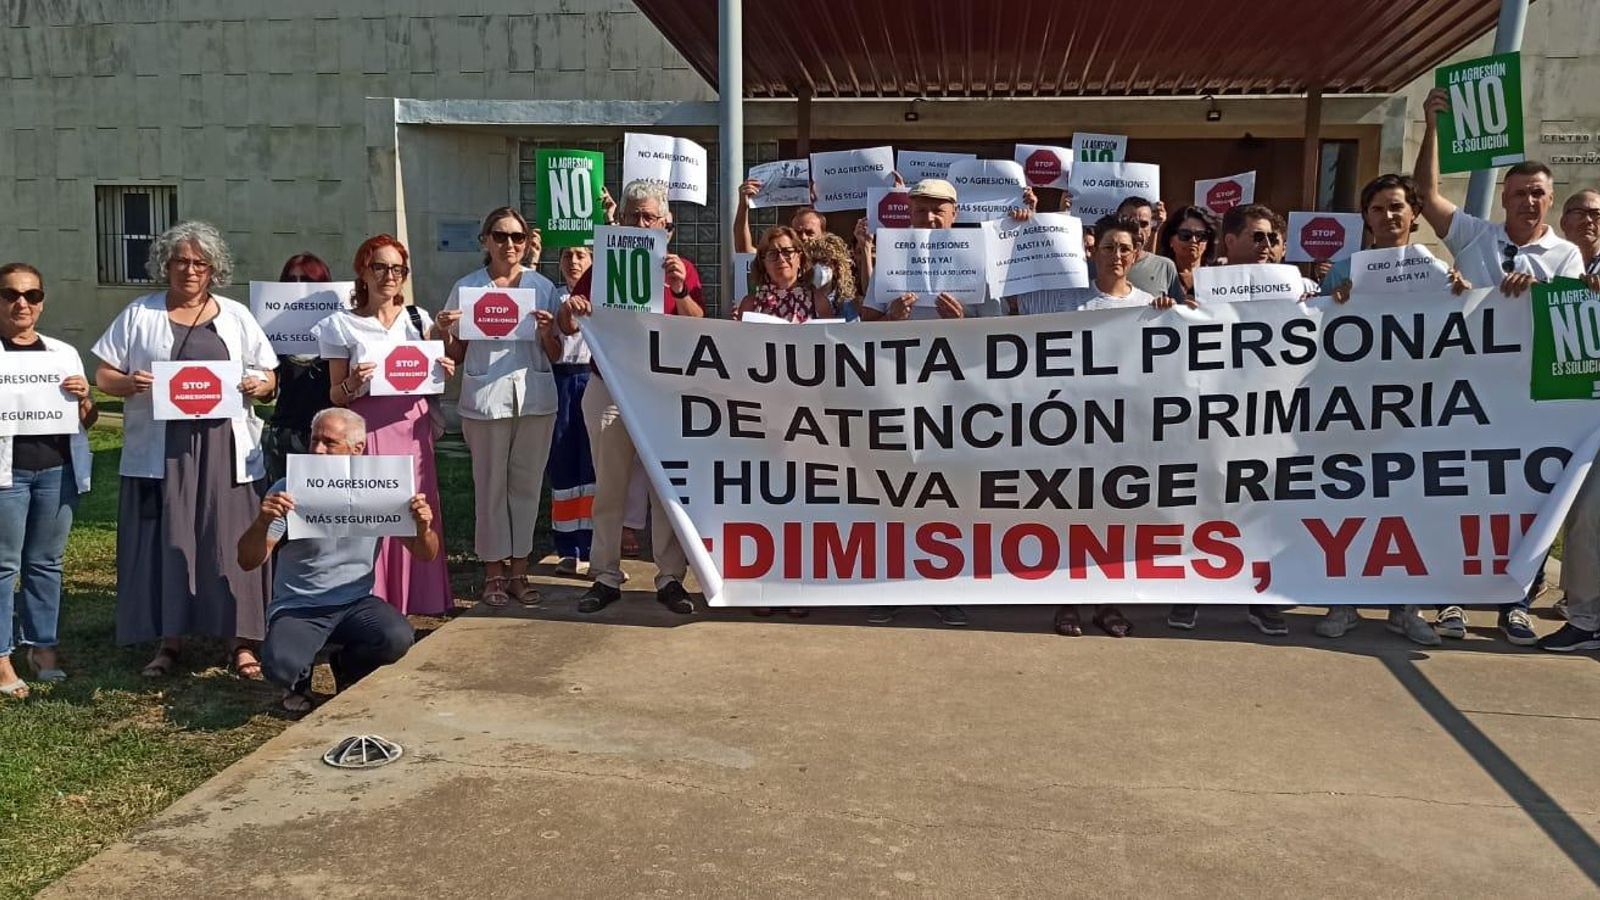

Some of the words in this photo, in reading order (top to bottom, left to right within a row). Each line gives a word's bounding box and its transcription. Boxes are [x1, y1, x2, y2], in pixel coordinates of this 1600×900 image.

[1449, 70, 1460, 85] LA
[1461, 61, 1506, 82] AGRESIÓN
[1449, 75, 1508, 141] NO
[1452, 139, 1464, 154] ES
[548, 157, 557, 169] LA
[558, 156, 593, 170] AGRESIÓN
[838, 164, 884, 174] AGRESIONES
[955, 176, 968, 185] NO
[969, 176, 1019, 186] AGRESIONES
[1083, 179, 1096, 187] NO
[1098, 179, 1150, 189] AGRESIONES
[549, 168, 593, 219] NO
[1216, 190, 1236, 198] STOP
[548, 219, 557, 231] ES
[999, 229, 1020, 240] CERO
[1312, 229, 1336, 237] STOP
[607, 234, 615, 248] LA
[618, 234, 655, 251] AGRESIÓN
[895, 241, 916, 249] CERO
[920, 241, 970, 250] AGRESIONES
[939, 256, 952, 264] YA!
[1367, 262, 1391, 271] CERO
[607, 248, 651, 305] NO
[1385, 273, 1412, 283] BASTA
[1414, 271, 1430, 280] YA!
[1212, 287, 1227, 296] NO
[1230, 283, 1291, 295] AGRESIONES
[1547, 291, 1560, 306] LA
[265, 301, 281, 311] NO
[284, 301, 345, 311] AGRESIONES
[485, 306, 509, 314] STOP
[1549, 300, 1600, 362] NO
[650, 330, 730, 379] LA
[747, 337, 965, 388] JUNTA
[986, 330, 1118, 380] DEL
[1142, 308, 1521, 374] PERSONAL
[1552, 361, 1564, 376] ES
[1565, 360, 1600, 375] SOLUCI
[182, 381, 211, 390] STOP
[1, 410, 63, 421] EGURIDAD
[681, 395, 766, 439] DE
[784, 389, 1125, 450] ATENCIÓN
[1152, 379, 1490, 442] PRIMARIA
[306, 479, 324, 488] NO
[327, 479, 399, 489] AGRESIONES
[714, 461, 960, 509] HUELVA
[980, 463, 1198, 510] EXIGE
[1224, 446, 1574, 504] RESPETO
[306, 514, 332, 524] MÁS
[335, 514, 401, 524] SEGURIDAD
[702, 520, 1271, 594] DIMISIONES,
[1301, 516, 1429, 578] YA
